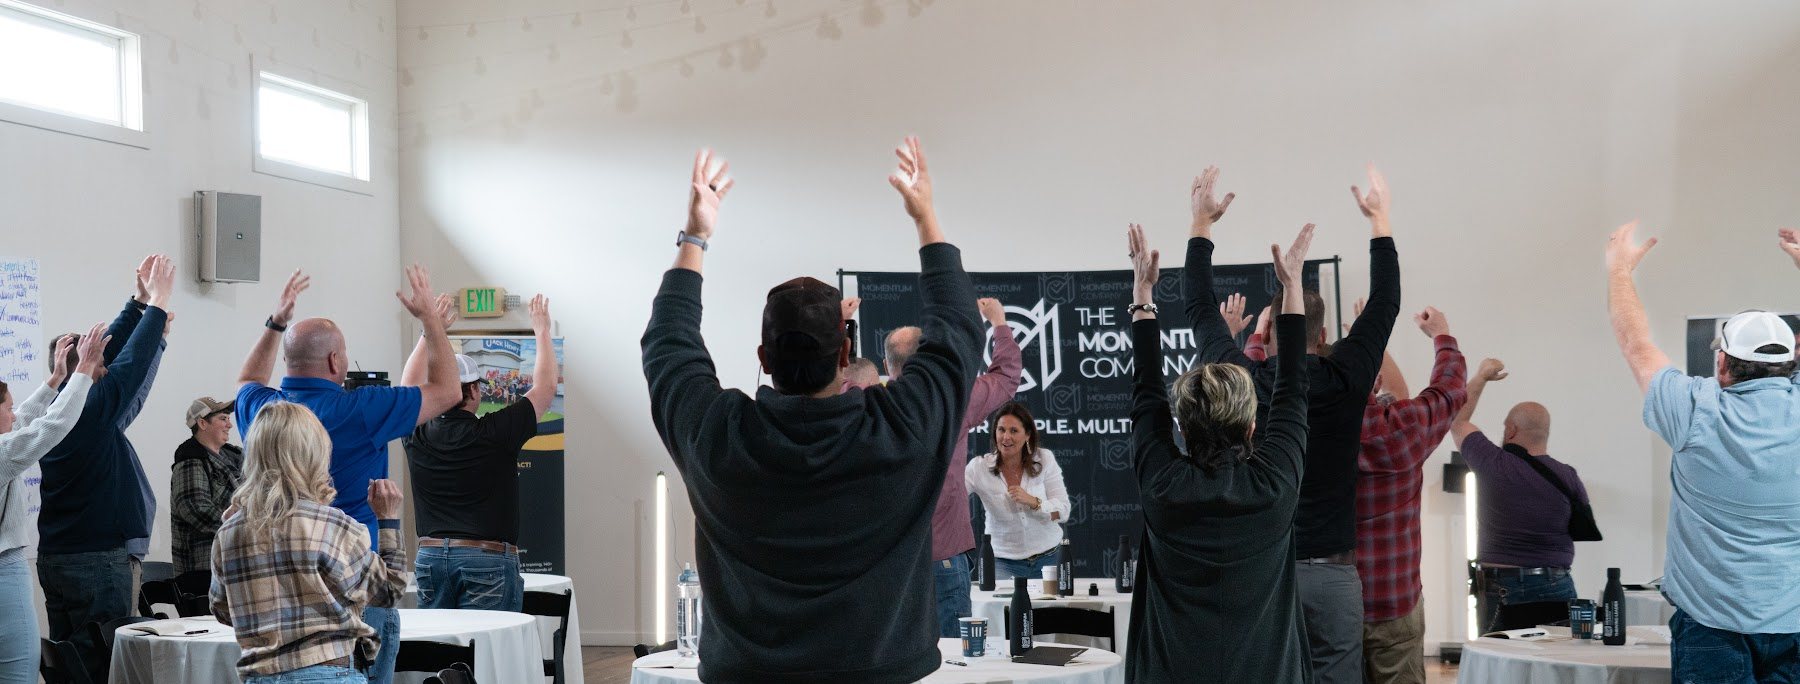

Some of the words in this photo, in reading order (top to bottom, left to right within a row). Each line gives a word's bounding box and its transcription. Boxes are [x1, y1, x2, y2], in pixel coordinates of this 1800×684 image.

[862, 284, 912, 292] MOMENTUM
[974, 284, 1021, 292] OMENTUM
[467, 289, 495, 312] EXIT
[1075, 307, 1116, 326] THE
[1080, 354, 1197, 378] COMNY
[1087, 393, 1132, 401] MOMENTU
[1033, 419, 1073, 434] PLE.
